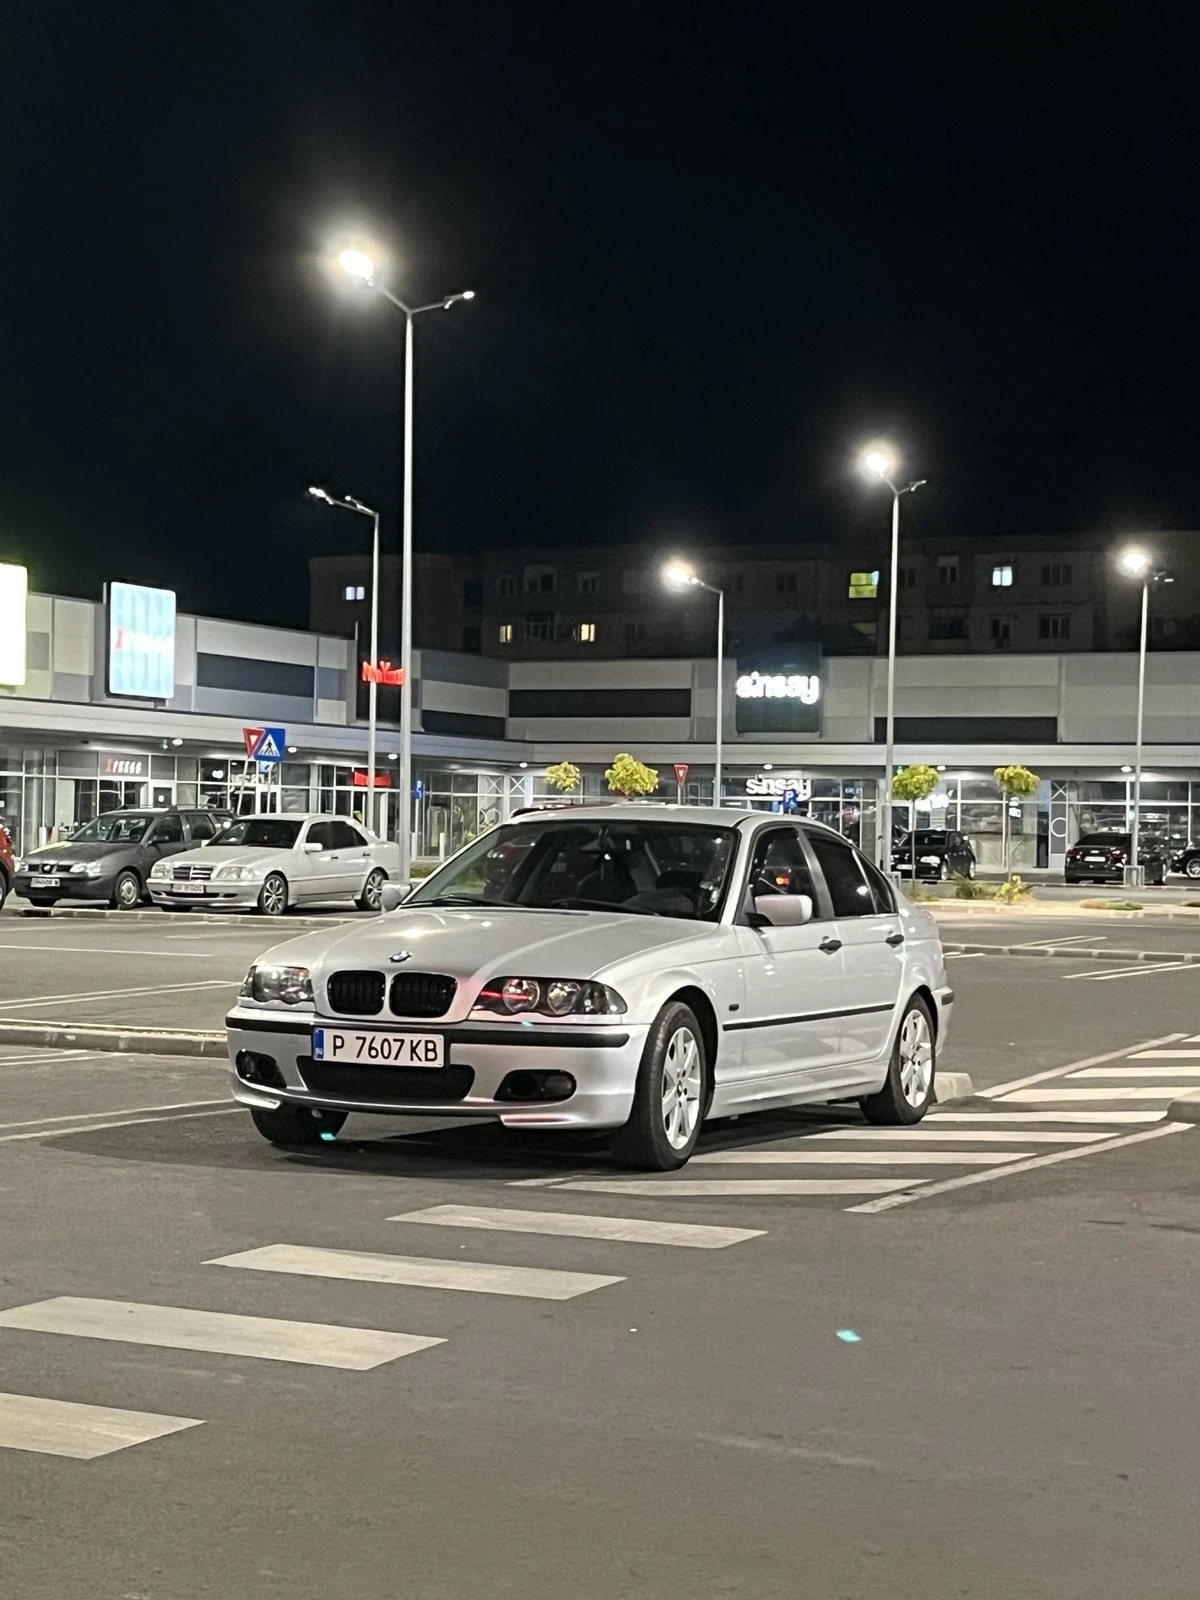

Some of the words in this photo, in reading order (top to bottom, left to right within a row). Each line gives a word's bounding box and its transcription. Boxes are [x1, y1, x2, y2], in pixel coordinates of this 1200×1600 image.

[745, 773, 812, 801] sinsay
[332, 1034, 345, 1057] P
[355, 1035, 405, 1061] 7607
[409, 1039, 438, 1062] KB
